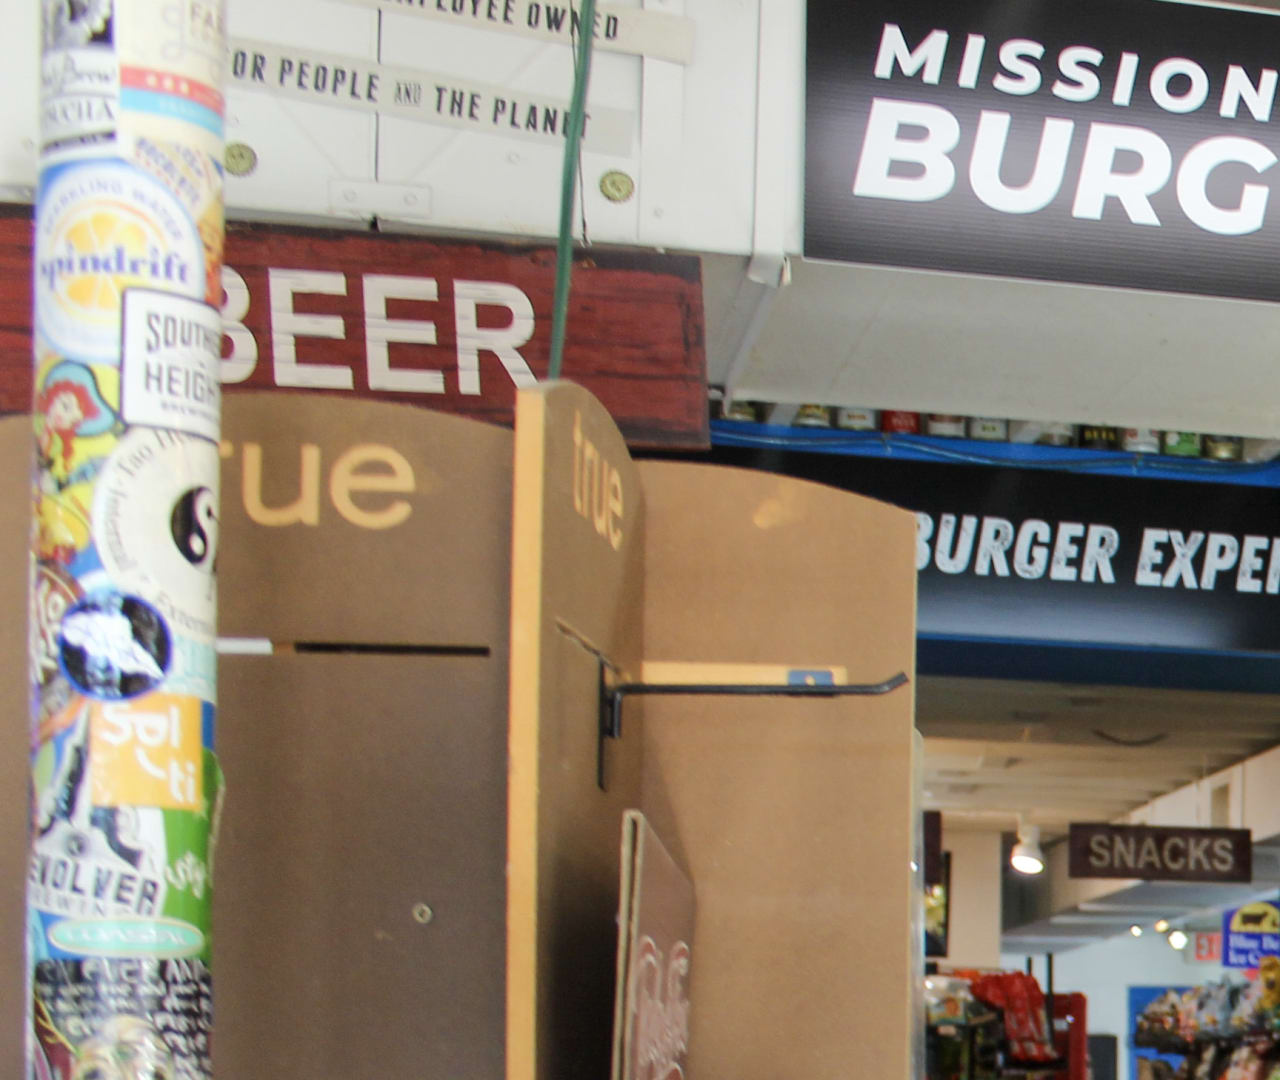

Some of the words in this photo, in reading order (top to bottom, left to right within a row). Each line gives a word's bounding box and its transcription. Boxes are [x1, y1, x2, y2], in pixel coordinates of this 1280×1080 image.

[278, 57, 380, 103] PEOPLE
[434, 86, 481, 121] THE
[873, 23, 1278, 123] MISSION
[41, 245, 190, 291] pindrift
[573, 411, 624, 551] true
[916, 511, 1119, 584] BURGER
[1089, 834, 1235, 872] SNACKS
